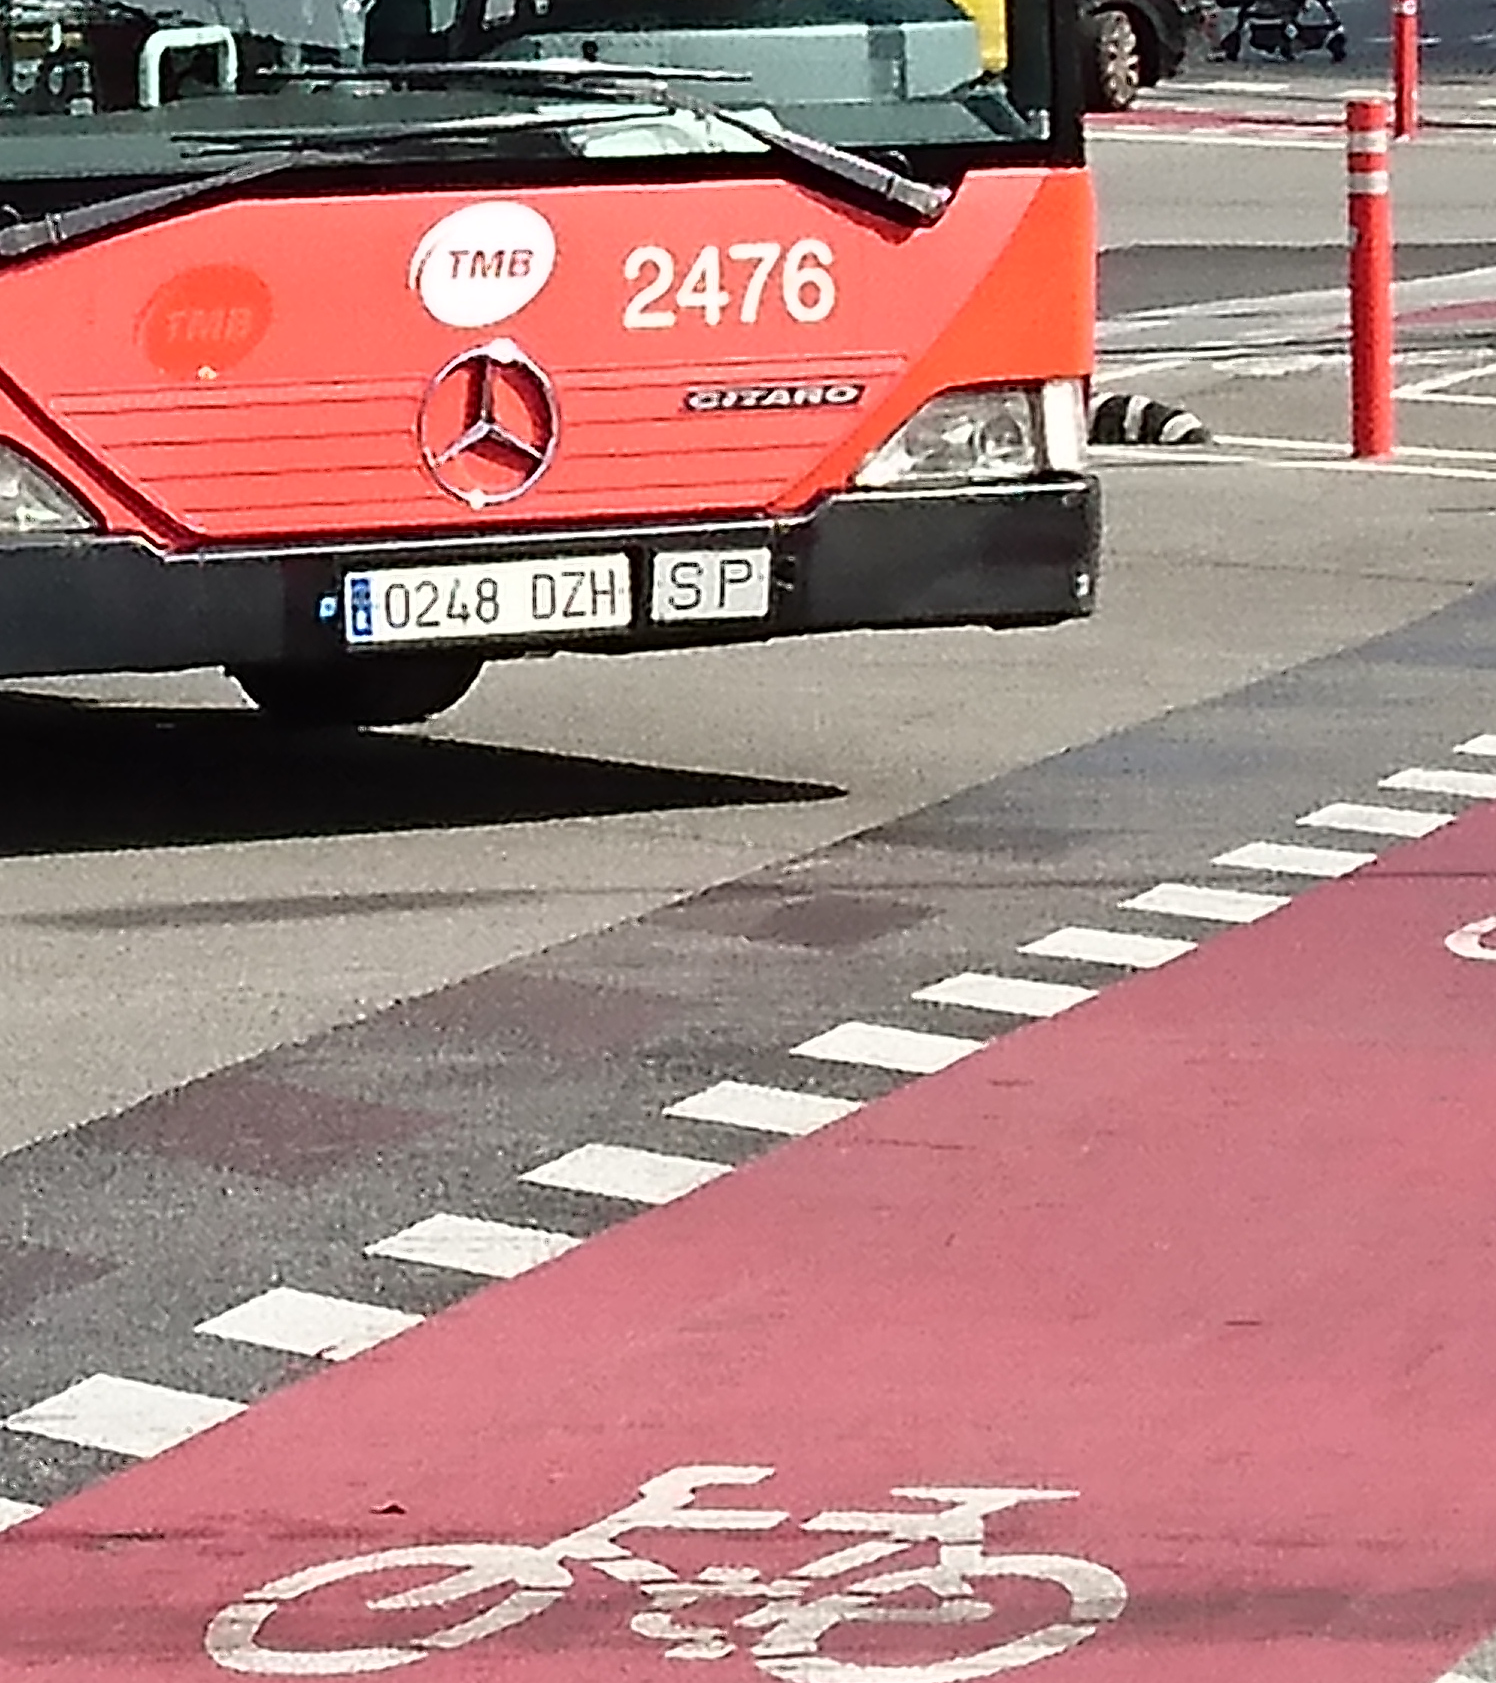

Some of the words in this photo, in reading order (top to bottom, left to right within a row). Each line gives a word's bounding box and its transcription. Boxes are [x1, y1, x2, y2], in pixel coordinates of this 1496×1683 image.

[448, 247, 535, 280] TMB
[622, 238, 836, 329] 2476
[163, 306, 254, 343] TMB
[383, 577, 500, 630] 0248
[531, 568, 617, 621] DZH
